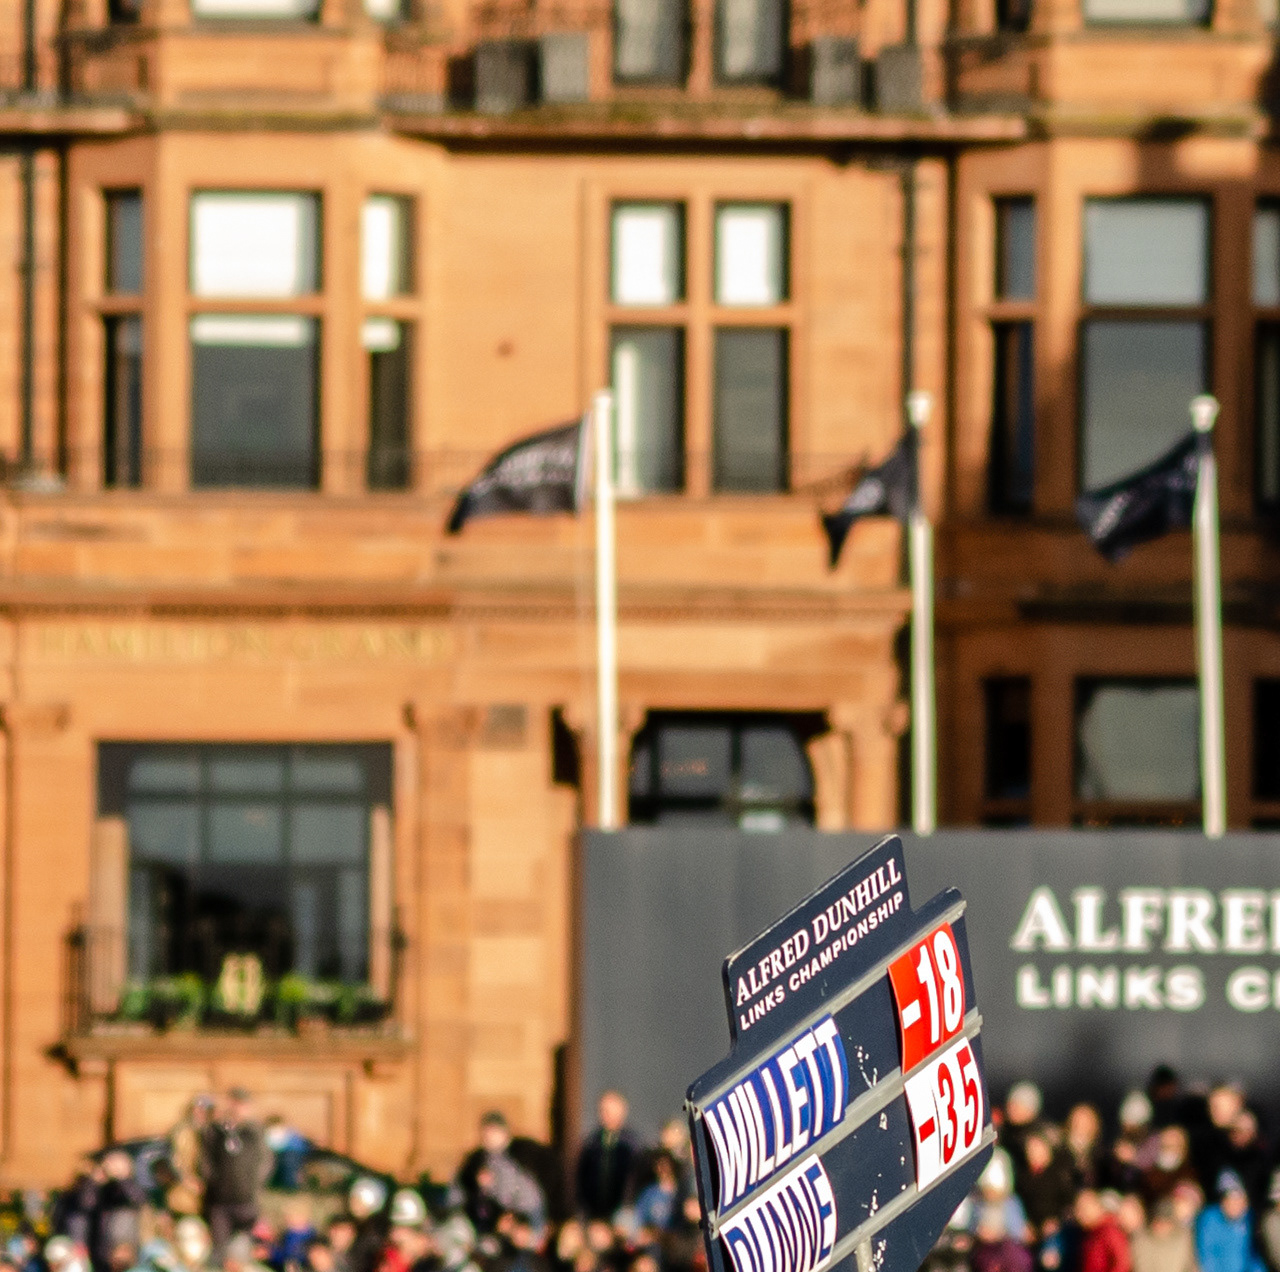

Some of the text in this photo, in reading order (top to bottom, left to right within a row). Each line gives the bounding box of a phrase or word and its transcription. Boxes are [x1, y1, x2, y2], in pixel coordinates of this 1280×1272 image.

[736, 858, 902, 1006] ALFRED DUNHILL
[740, 891, 904, 1031] LINKS CHAMPIONSHIP
[902, 928, 963, 1043] -18
[1018, 966, 1205, 1010] LINKS
[704, 1018, 845, 1206] WILLETT
[918, 1044, 979, 1165] -35
